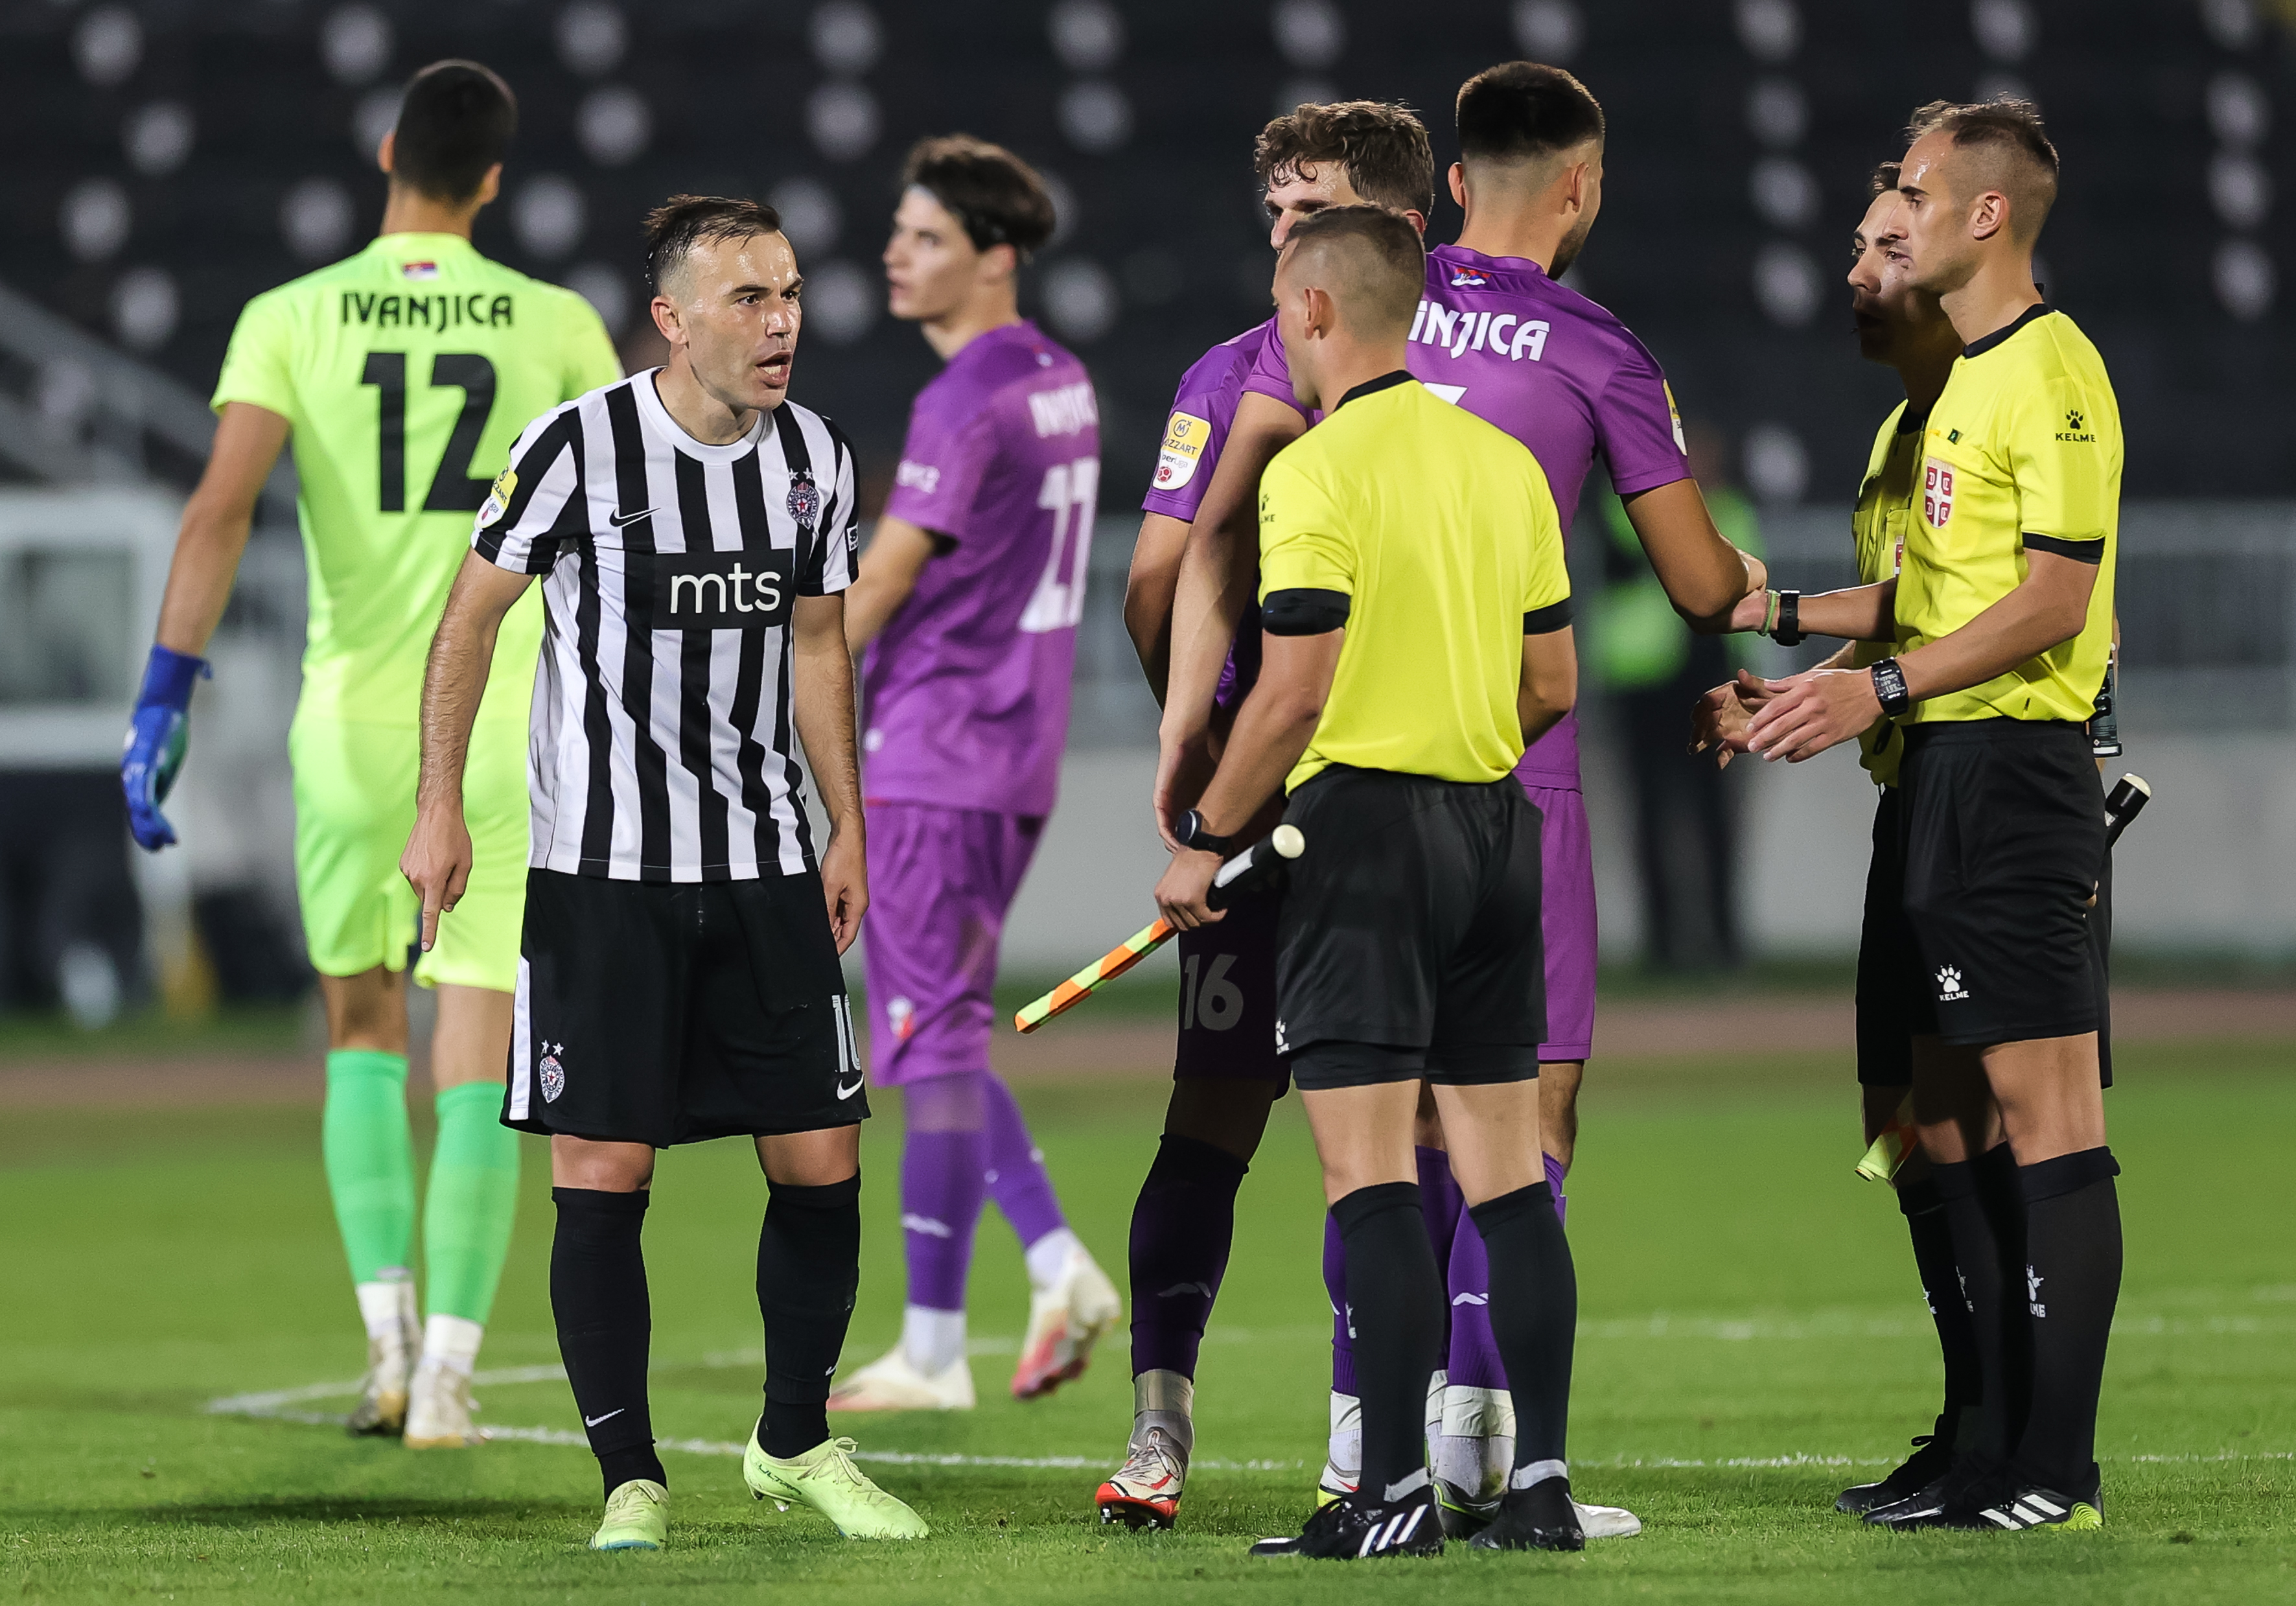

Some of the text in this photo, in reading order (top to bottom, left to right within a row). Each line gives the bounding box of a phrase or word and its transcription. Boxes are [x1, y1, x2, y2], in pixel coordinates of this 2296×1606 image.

[342, 292, 514, 334] IVANJICA
[360, 352, 498, 513] 12
[2056, 433, 2096, 443] KELME
[670, 562, 782, 614] mts
[1184, 953, 1244, 1031] 16
[1939, 990, 1969, 1001] KELME
